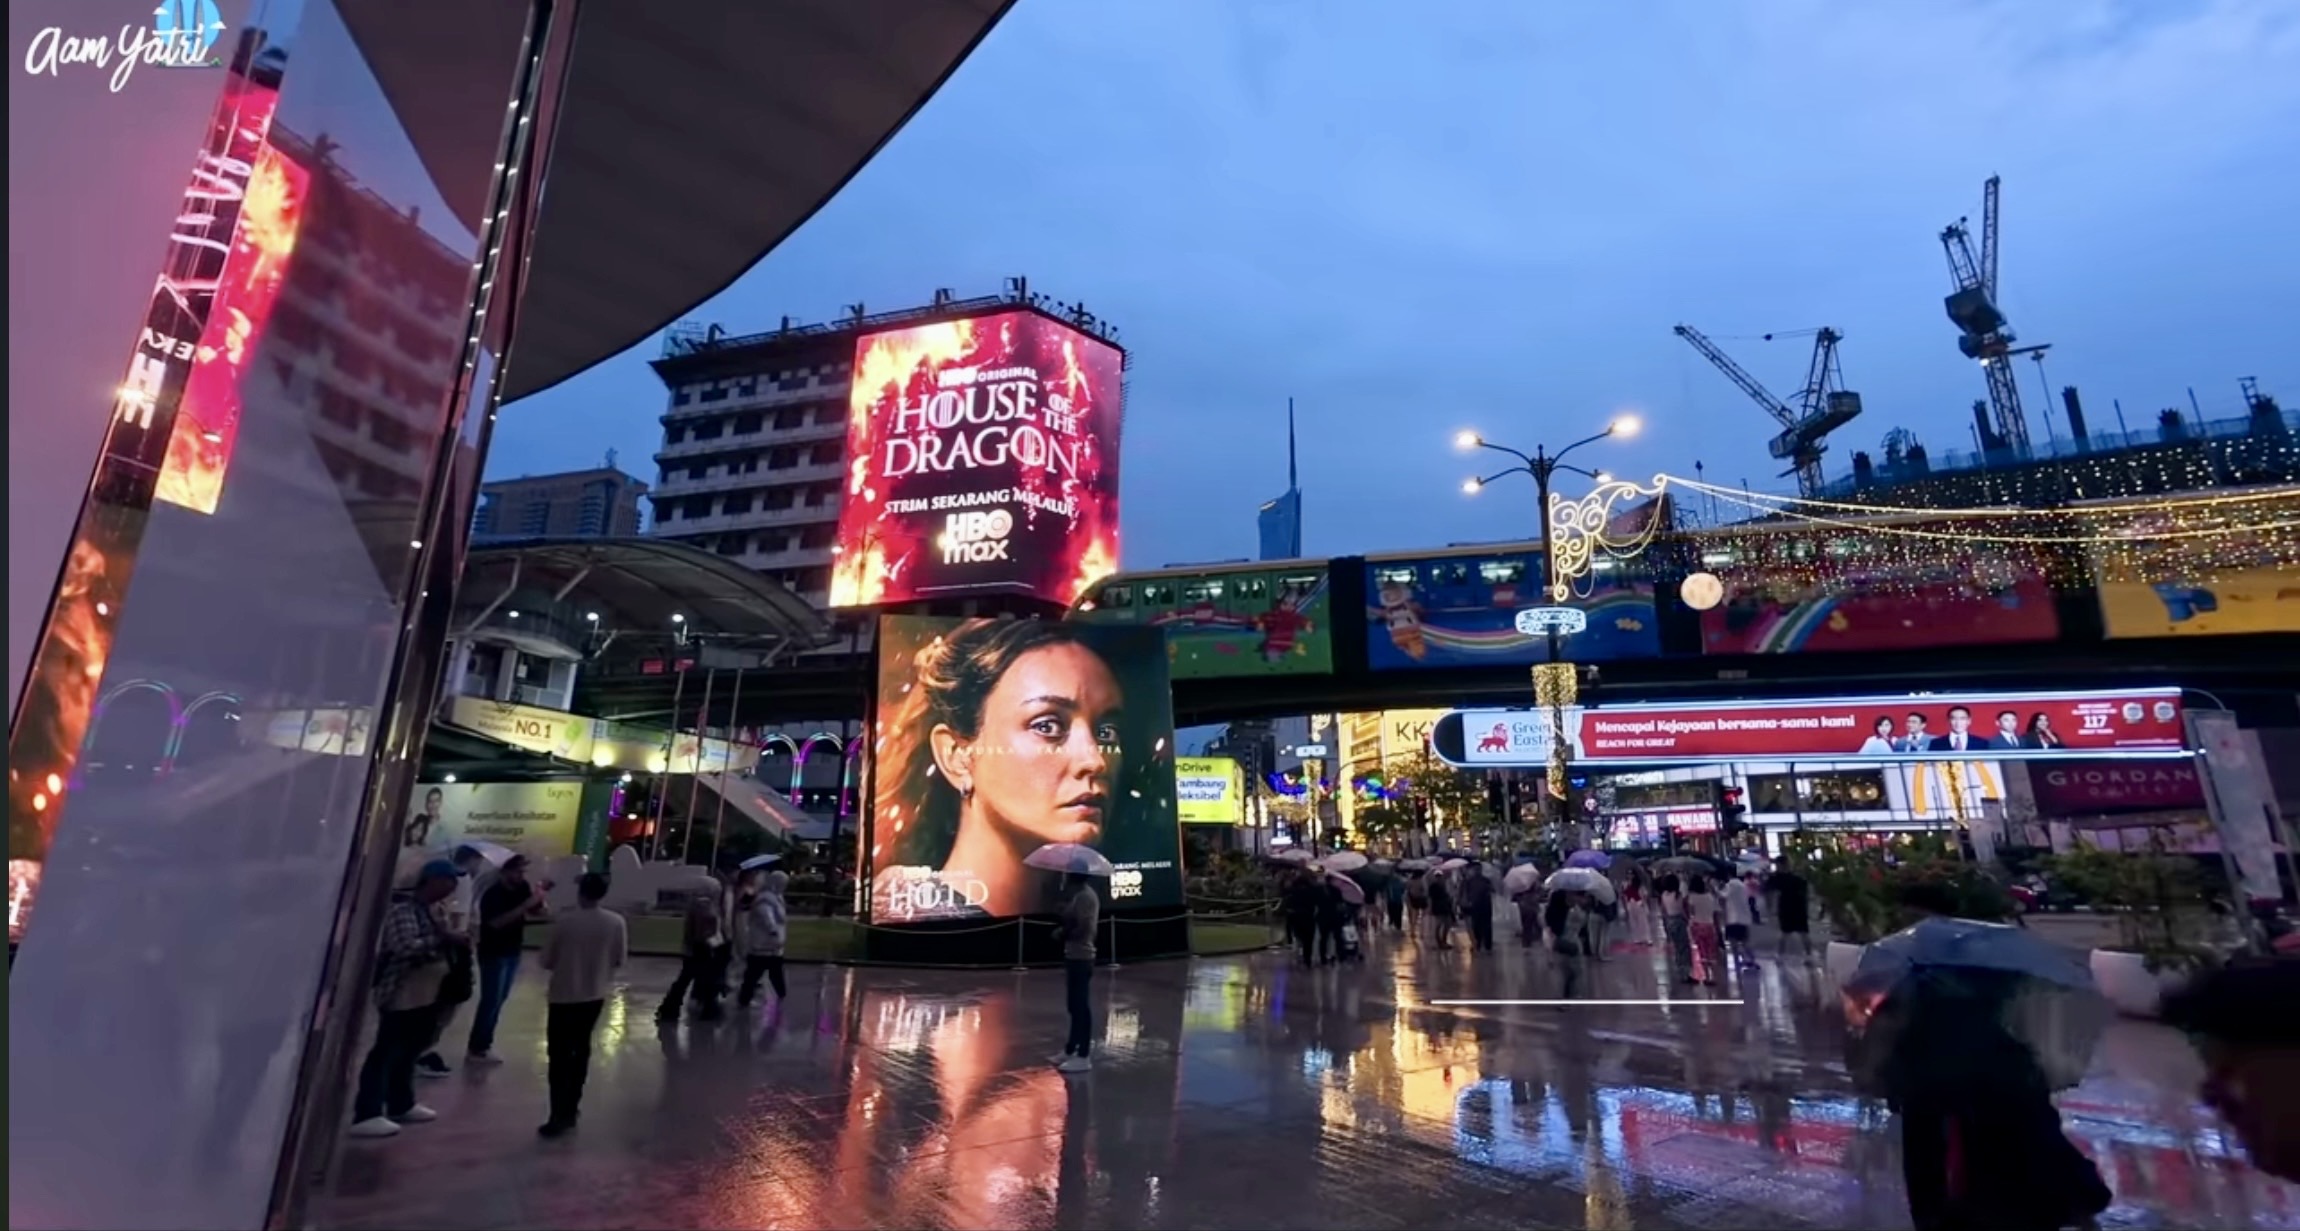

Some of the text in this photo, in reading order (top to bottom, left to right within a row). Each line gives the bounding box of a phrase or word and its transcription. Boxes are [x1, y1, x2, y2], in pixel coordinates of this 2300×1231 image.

[940, 366, 1038, 387] HBO ORIGINAL
[895, 381, 1036, 434] HOUSE
[1048, 393, 1073, 414] OF
[1041, 407, 1078, 436] THE
[882, 425, 1083, 484] DRAGON
[885, 487, 1075, 517] STRIM SEKARANG MELALUI
[944, 508, 1013, 542] HBO
[943, 538, 1010, 565] max
[1595, 714, 1856, 735] Mencapai Kejayaan bersama-sama kami
[2083, 714, 2108, 729] 117
[1596, 738, 1675, 748] REACH FOR GREAT
[1175, 762, 1213, 773] nDrive
[2047, 769, 2194, 786] GIORDAN
[1177, 778, 1226, 791] ambang
[1178, 790, 1221, 800] leksibel
[1110, 870, 1143, 887] HBO
